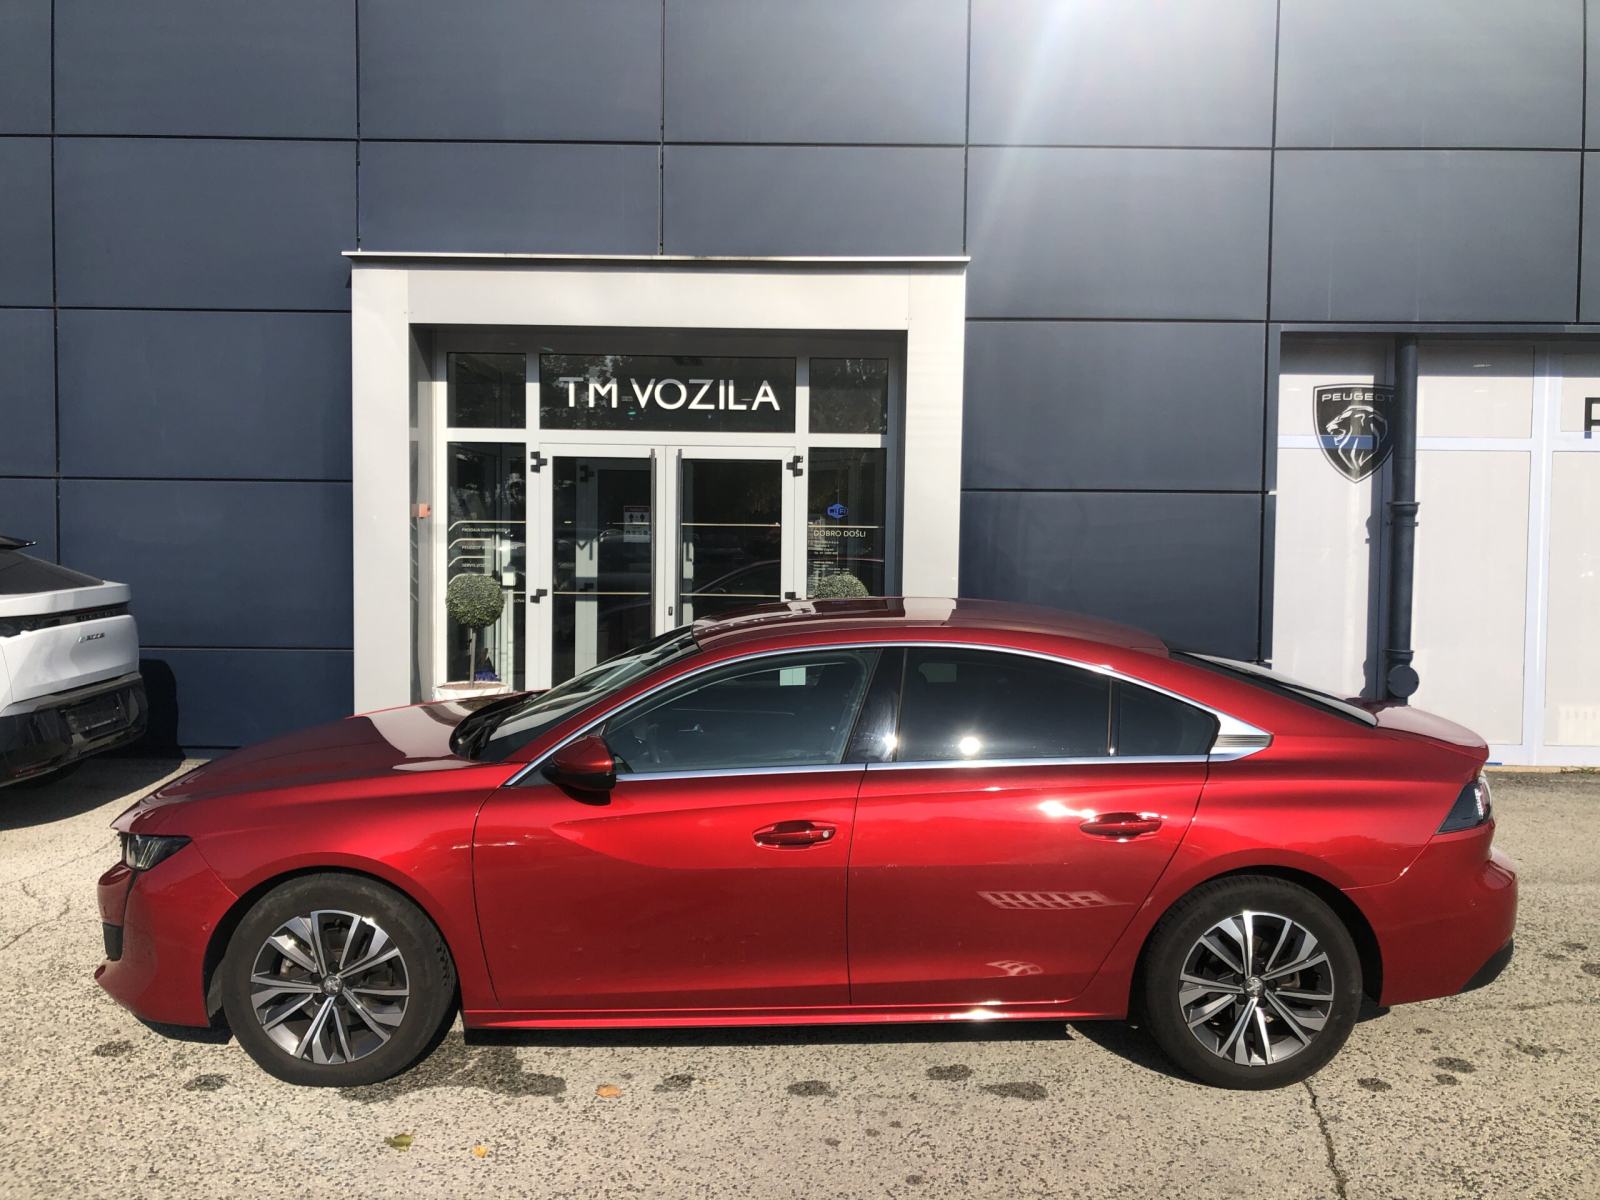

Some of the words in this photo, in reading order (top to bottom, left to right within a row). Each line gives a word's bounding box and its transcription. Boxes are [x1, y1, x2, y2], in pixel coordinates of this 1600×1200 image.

[558, 376, 618, 409] TM
[629, 377, 781, 411] VOZILA
[1321, 392, 1395, 402] PEUGEOT
[843, 529, 866, 538] DOŠLI
